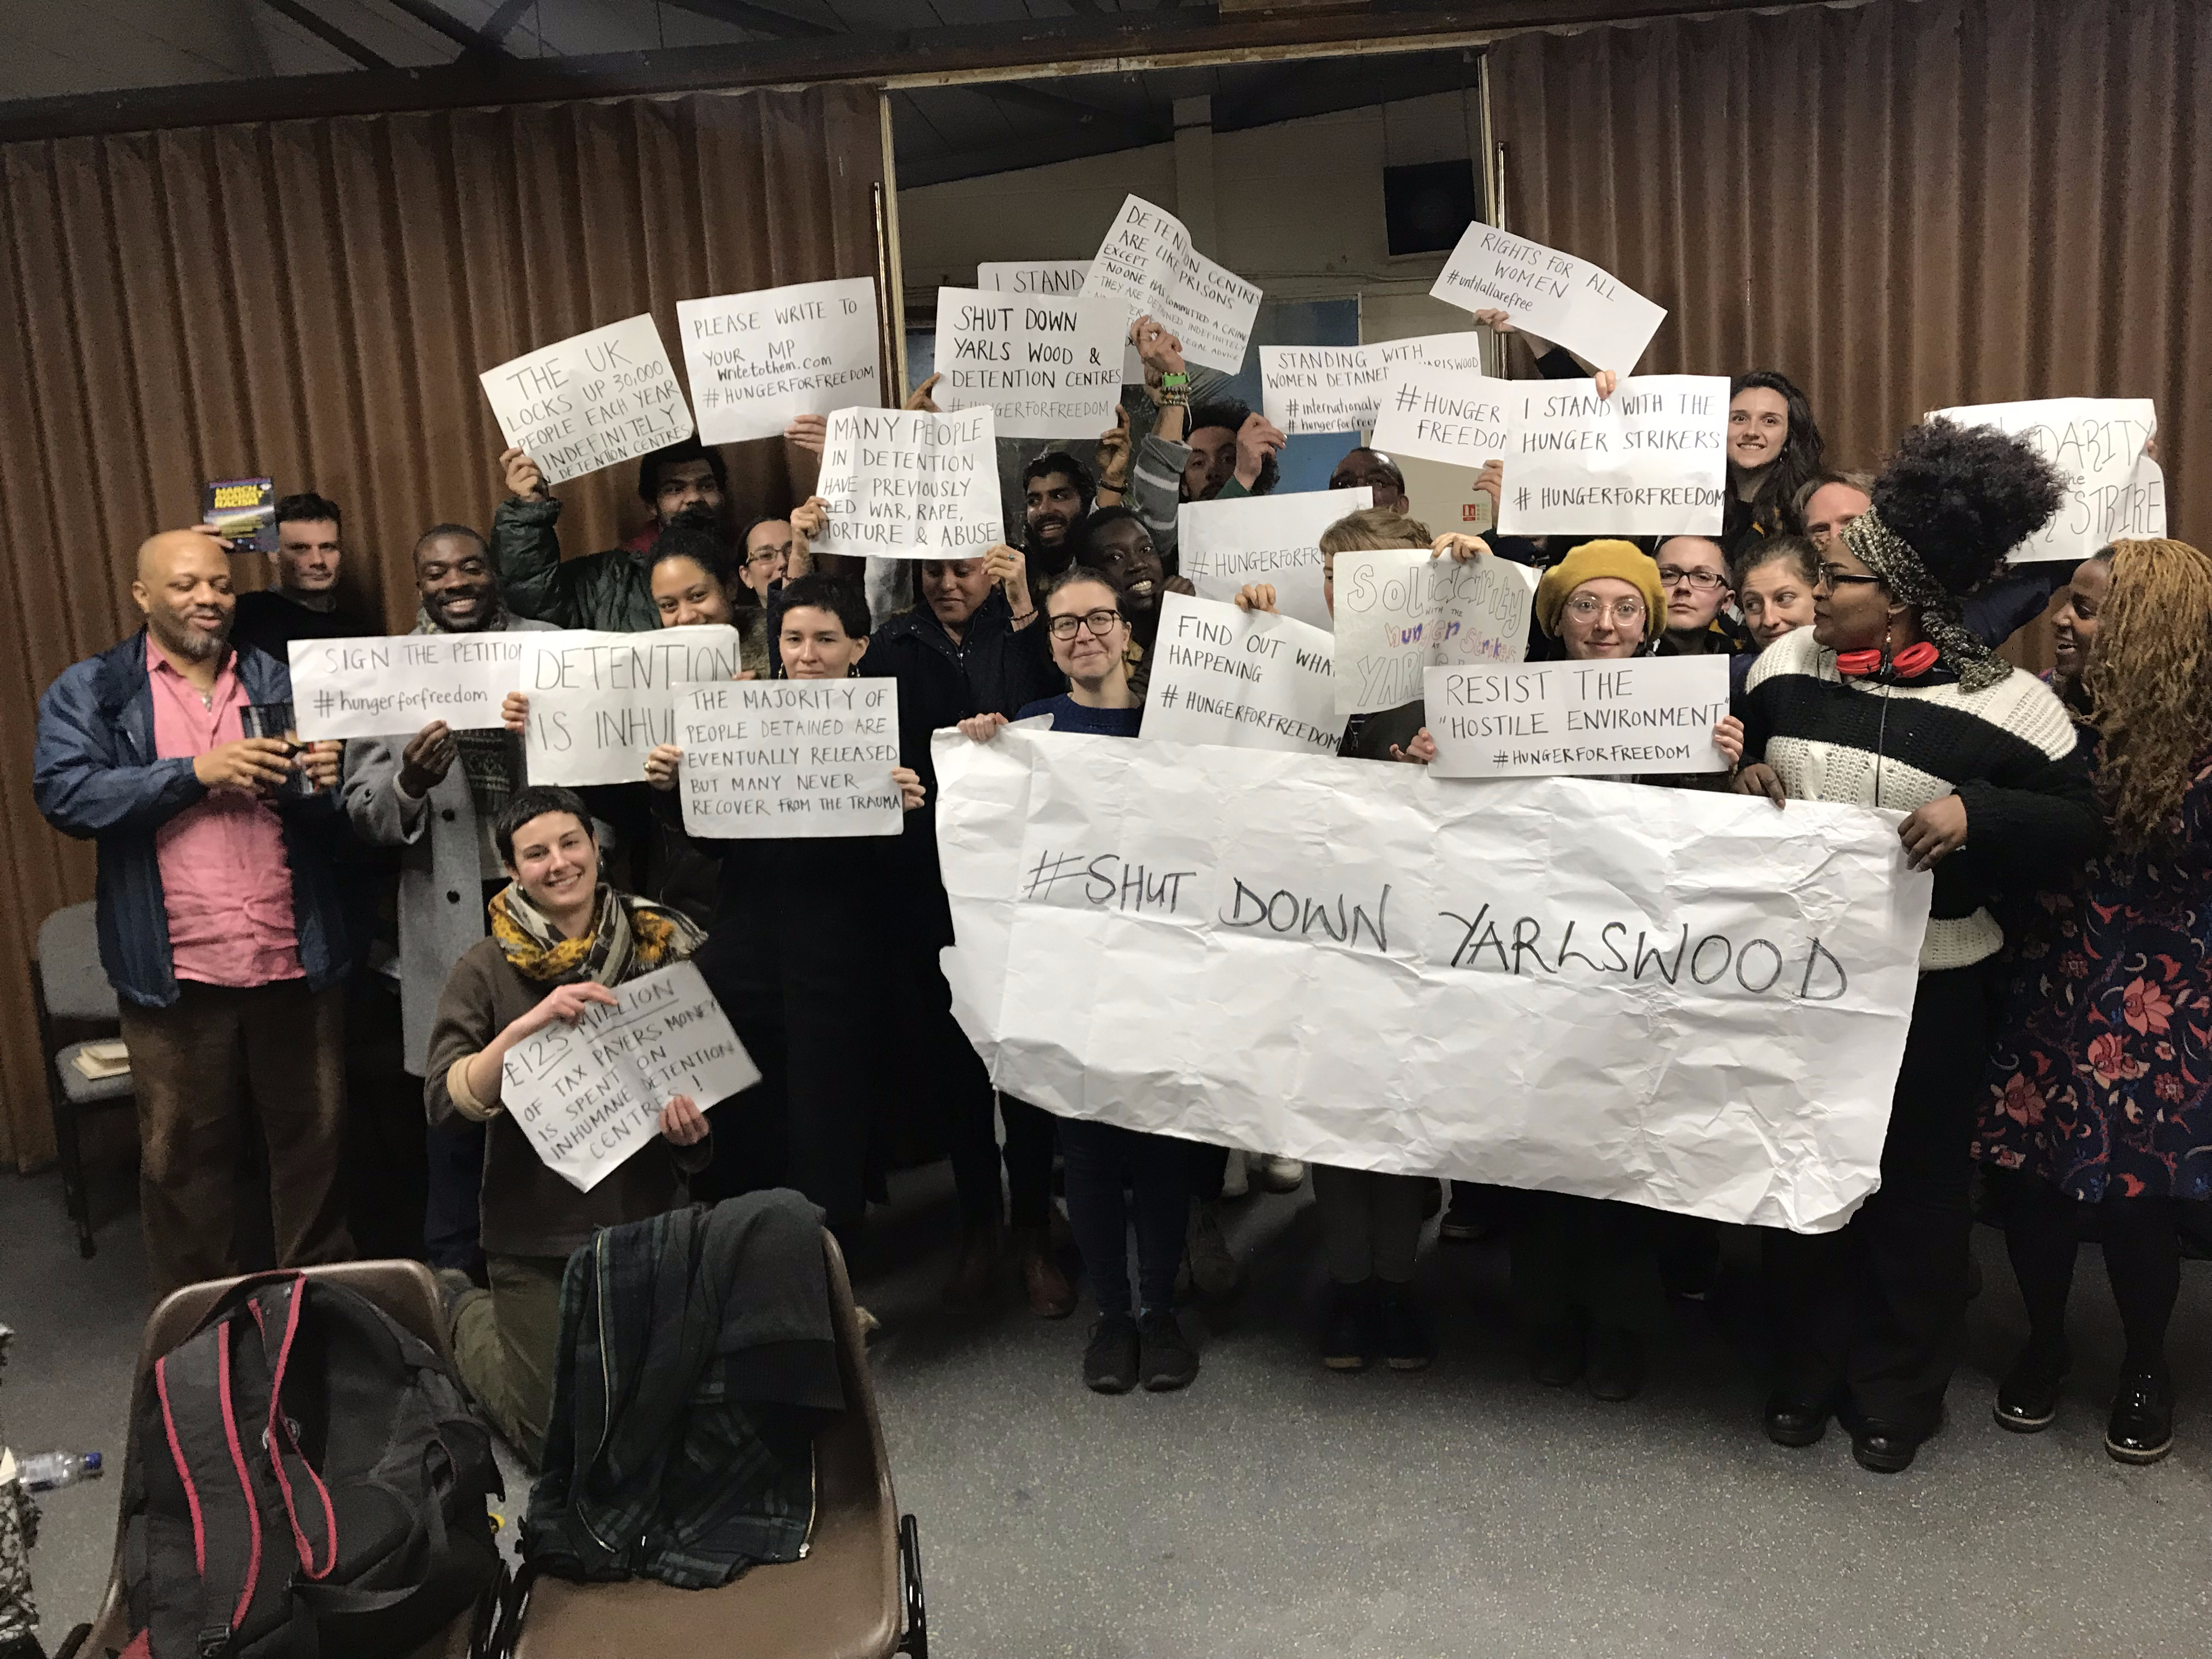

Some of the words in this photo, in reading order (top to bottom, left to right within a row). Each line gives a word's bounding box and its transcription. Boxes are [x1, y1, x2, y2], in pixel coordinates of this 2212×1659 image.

[1104, 243, 1149, 267] EXCEPT
[1119, 229, 1149, 252] ARE
[1156, 245, 1180, 273] LIKE
[1179, 270, 1235, 309] PRISONS
[1481, 232, 1542, 266] RIGHTS
[1546, 256, 1574, 278] FOR
[1585, 273, 1616, 302] ALL
[996, 273, 1000, 291] I
[1014, 269, 1085, 293] STAND
[1446, 269, 1533, 312] #untilallarefree
[1494, 259, 1570, 298] WOMEN
[1125, 287, 1143, 300] ARE
[693, 312, 761, 339] PLEASE
[775, 301, 827, 325] WRITE
[954, 306, 1014, 331] SHUT
[1026, 308, 1077, 332] DOWN
[1212, 320, 1218, 329] A
[703, 348, 746, 367] YOUR
[769, 338, 795, 359] MP
[954, 337, 1012, 361] YARLS
[1028, 342, 1073, 365] WOOD
[1090, 347, 1101, 366] &
[1278, 351, 1367, 370] STANDING
[1382, 343, 1424, 363] WITH
[506, 358, 569, 400] THE
[585, 340, 633, 372] UK
[951, 369, 1056, 388] DETENTION
[1065, 369, 1121, 387] CENTRES
[1266, 372, 1317, 390] WOMEN
[506, 393, 572, 432] LOCKS
[582, 379, 605, 402] UP
[613, 361, 663, 392] 30,000
[1395, 383, 1500, 423] #HUNGER
[1525, 398, 1529, 419] I
[1544, 396, 1610, 417] STAND
[1622, 393, 1662, 415] WITH
[1679, 394, 1716, 415] THE
[517, 418, 575, 452] PEOPLE
[584, 398, 628, 426] EACH
[633, 379, 680, 408] YEAR
[835, 416, 900, 442] MANY
[913, 417, 983, 446] PEOPLE
[1523, 430, 1608, 453] HUNGER
[1623, 430, 1720, 450] STRIKERS
[559, 446, 628, 480] DETENTION
[633, 425, 691, 454] CENTRES
[832, 450, 847, 466] IN
[862, 448, 974, 472] DETENTION
[823, 476, 859, 495] HAVE
[873, 478, 971, 498] PREVIOUSLY
[870, 500, 911, 521] WAR,
[918, 503, 963, 522] RAPE,
[826, 519, 902, 544] TORTURE
[916, 527, 928, 545] &
[941, 522, 998, 547] ABUSE
[1425, 606, 1443, 616] WITH
[1451, 608, 1464, 617] THE
[1178, 615, 1233, 646] FIND
[1246, 635, 1286, 658] OUT
[325, 646, 389, 674] SIGN
[404, 643, 439, 665] THE
[535, 642, 736, 690] DETENTION
[1169, 644, 1263, 683] HAPPENING
[689, 689, 729, 711] THE
[743, 686, 856, 709] MAJORITY
[865, 689, 888, 708] OF
[1446, 670, 1553, 706] RESIST
[1573, 669, 1633, 701] THE
[538, 711, 572, 752] IS
[686, 721, 748, 744] PEOPLE
[761, 719, 843, 737] DETAINED
[855, 718, 887, 734] ARE
[688, 747, 800, 769] EVENTUALLY
[811, 744, 898, 765] RELEASED
[690, 778, 718, 794] BUT
[732, 775, 782, 792] MANY
[797, 773, 860, 790] NEVER
[692, 799, 771, 816] RECOVER
[777, 797, 811, 812] FROM
[819, 797, 842, 810] THE
[850, 794, 901, 810] TRAUMA
[1218, 877, 1392, 953] DOWN
[1438, 903, 1848, 1001] YARLSWOOD
[503, 1026, 569, 1087] £125
[578, 979, 674, 1036] MILLION
[524, 1098, 544, 1122] OF
[551, 1064, 588, 1097] TAX
[592, 1024, 663, 1067] PAYERS
[538, 1124, 558, 1142] IS
[566, 1066, 622, 1121] SPENT
[637, 1046, 667, 1070] ON
[550, 1086, 631, 1160] INHUMANE
